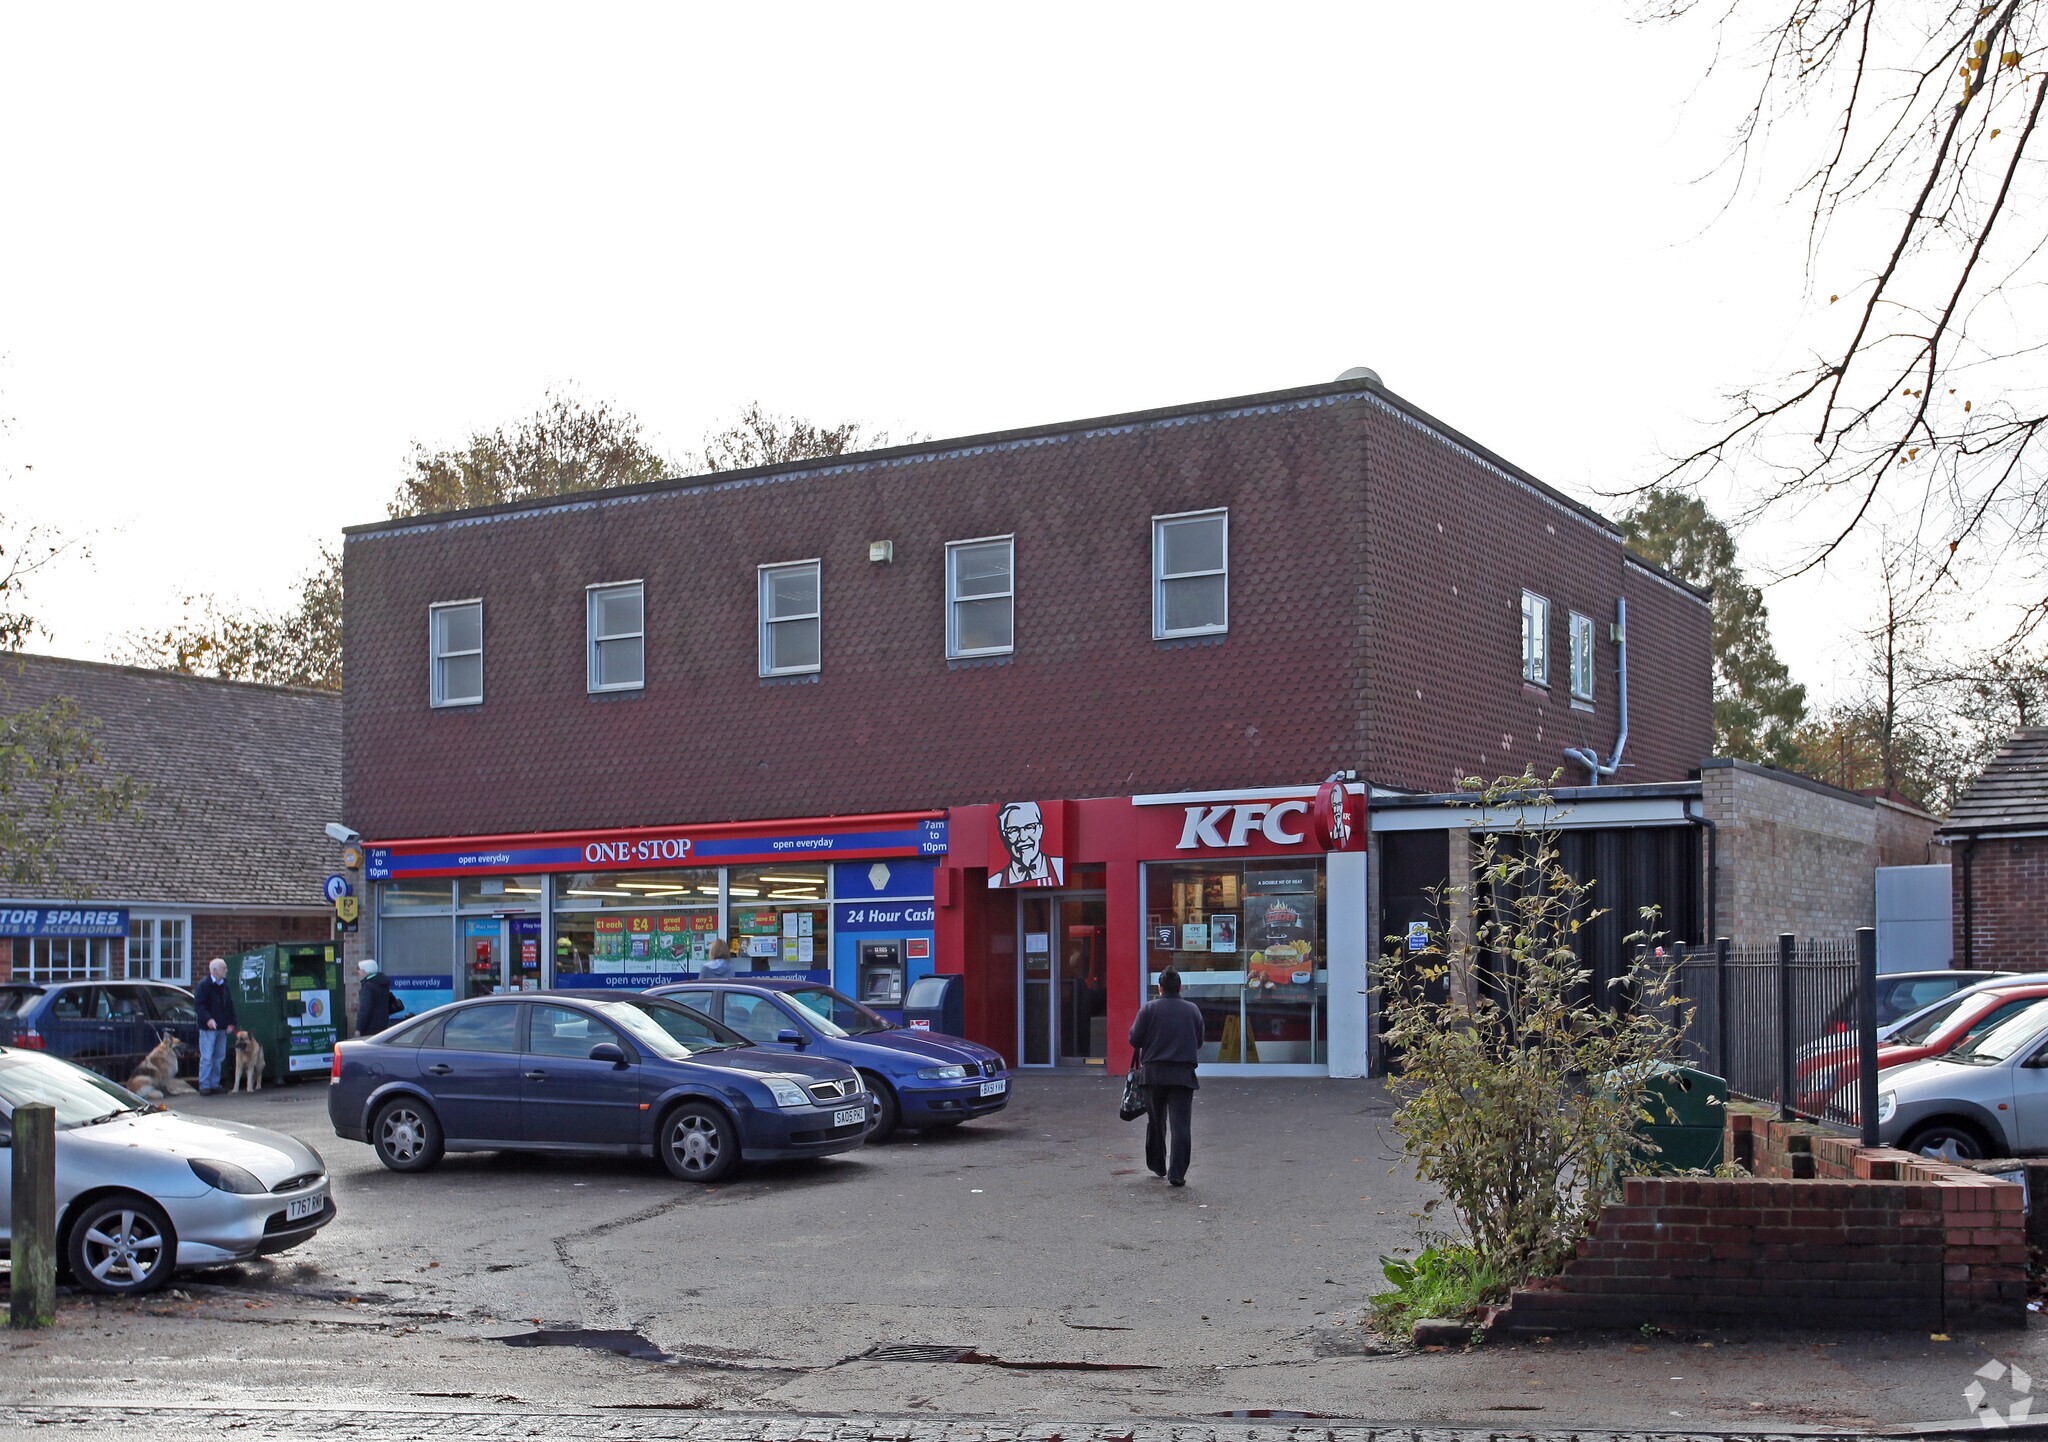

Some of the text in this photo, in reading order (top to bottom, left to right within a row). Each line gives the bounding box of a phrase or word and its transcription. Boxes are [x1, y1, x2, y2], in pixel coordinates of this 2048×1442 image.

[925, 820, 945, 829] 7am
[1176, 801, 1308, 849] KFC
[930, 831, 940, 840] to
[773, 837, 833, 850] open everyday
[922, 842, 947, 853] 10pm
[372, 849, 387, 857] 7am
[375, 858, 382, 866] to
[458, 853, 510, 866] open everyday
[369, 868, 388, 877] 10pm
[45, 911, 119, 926] SPARES
[664, 916, 680, 924] great
[847, 907, 935, 923] 24 Hour Cash
[596, 920, 604, 929] £1
[633, 918, 648, 931] £4
[41, 925, 122, 935] ACCESSORIES
[394, 977, 440, 987] open everyday
[605, 974, 672, 987] open everyday
[290, 1197, 311, 1216] T767
